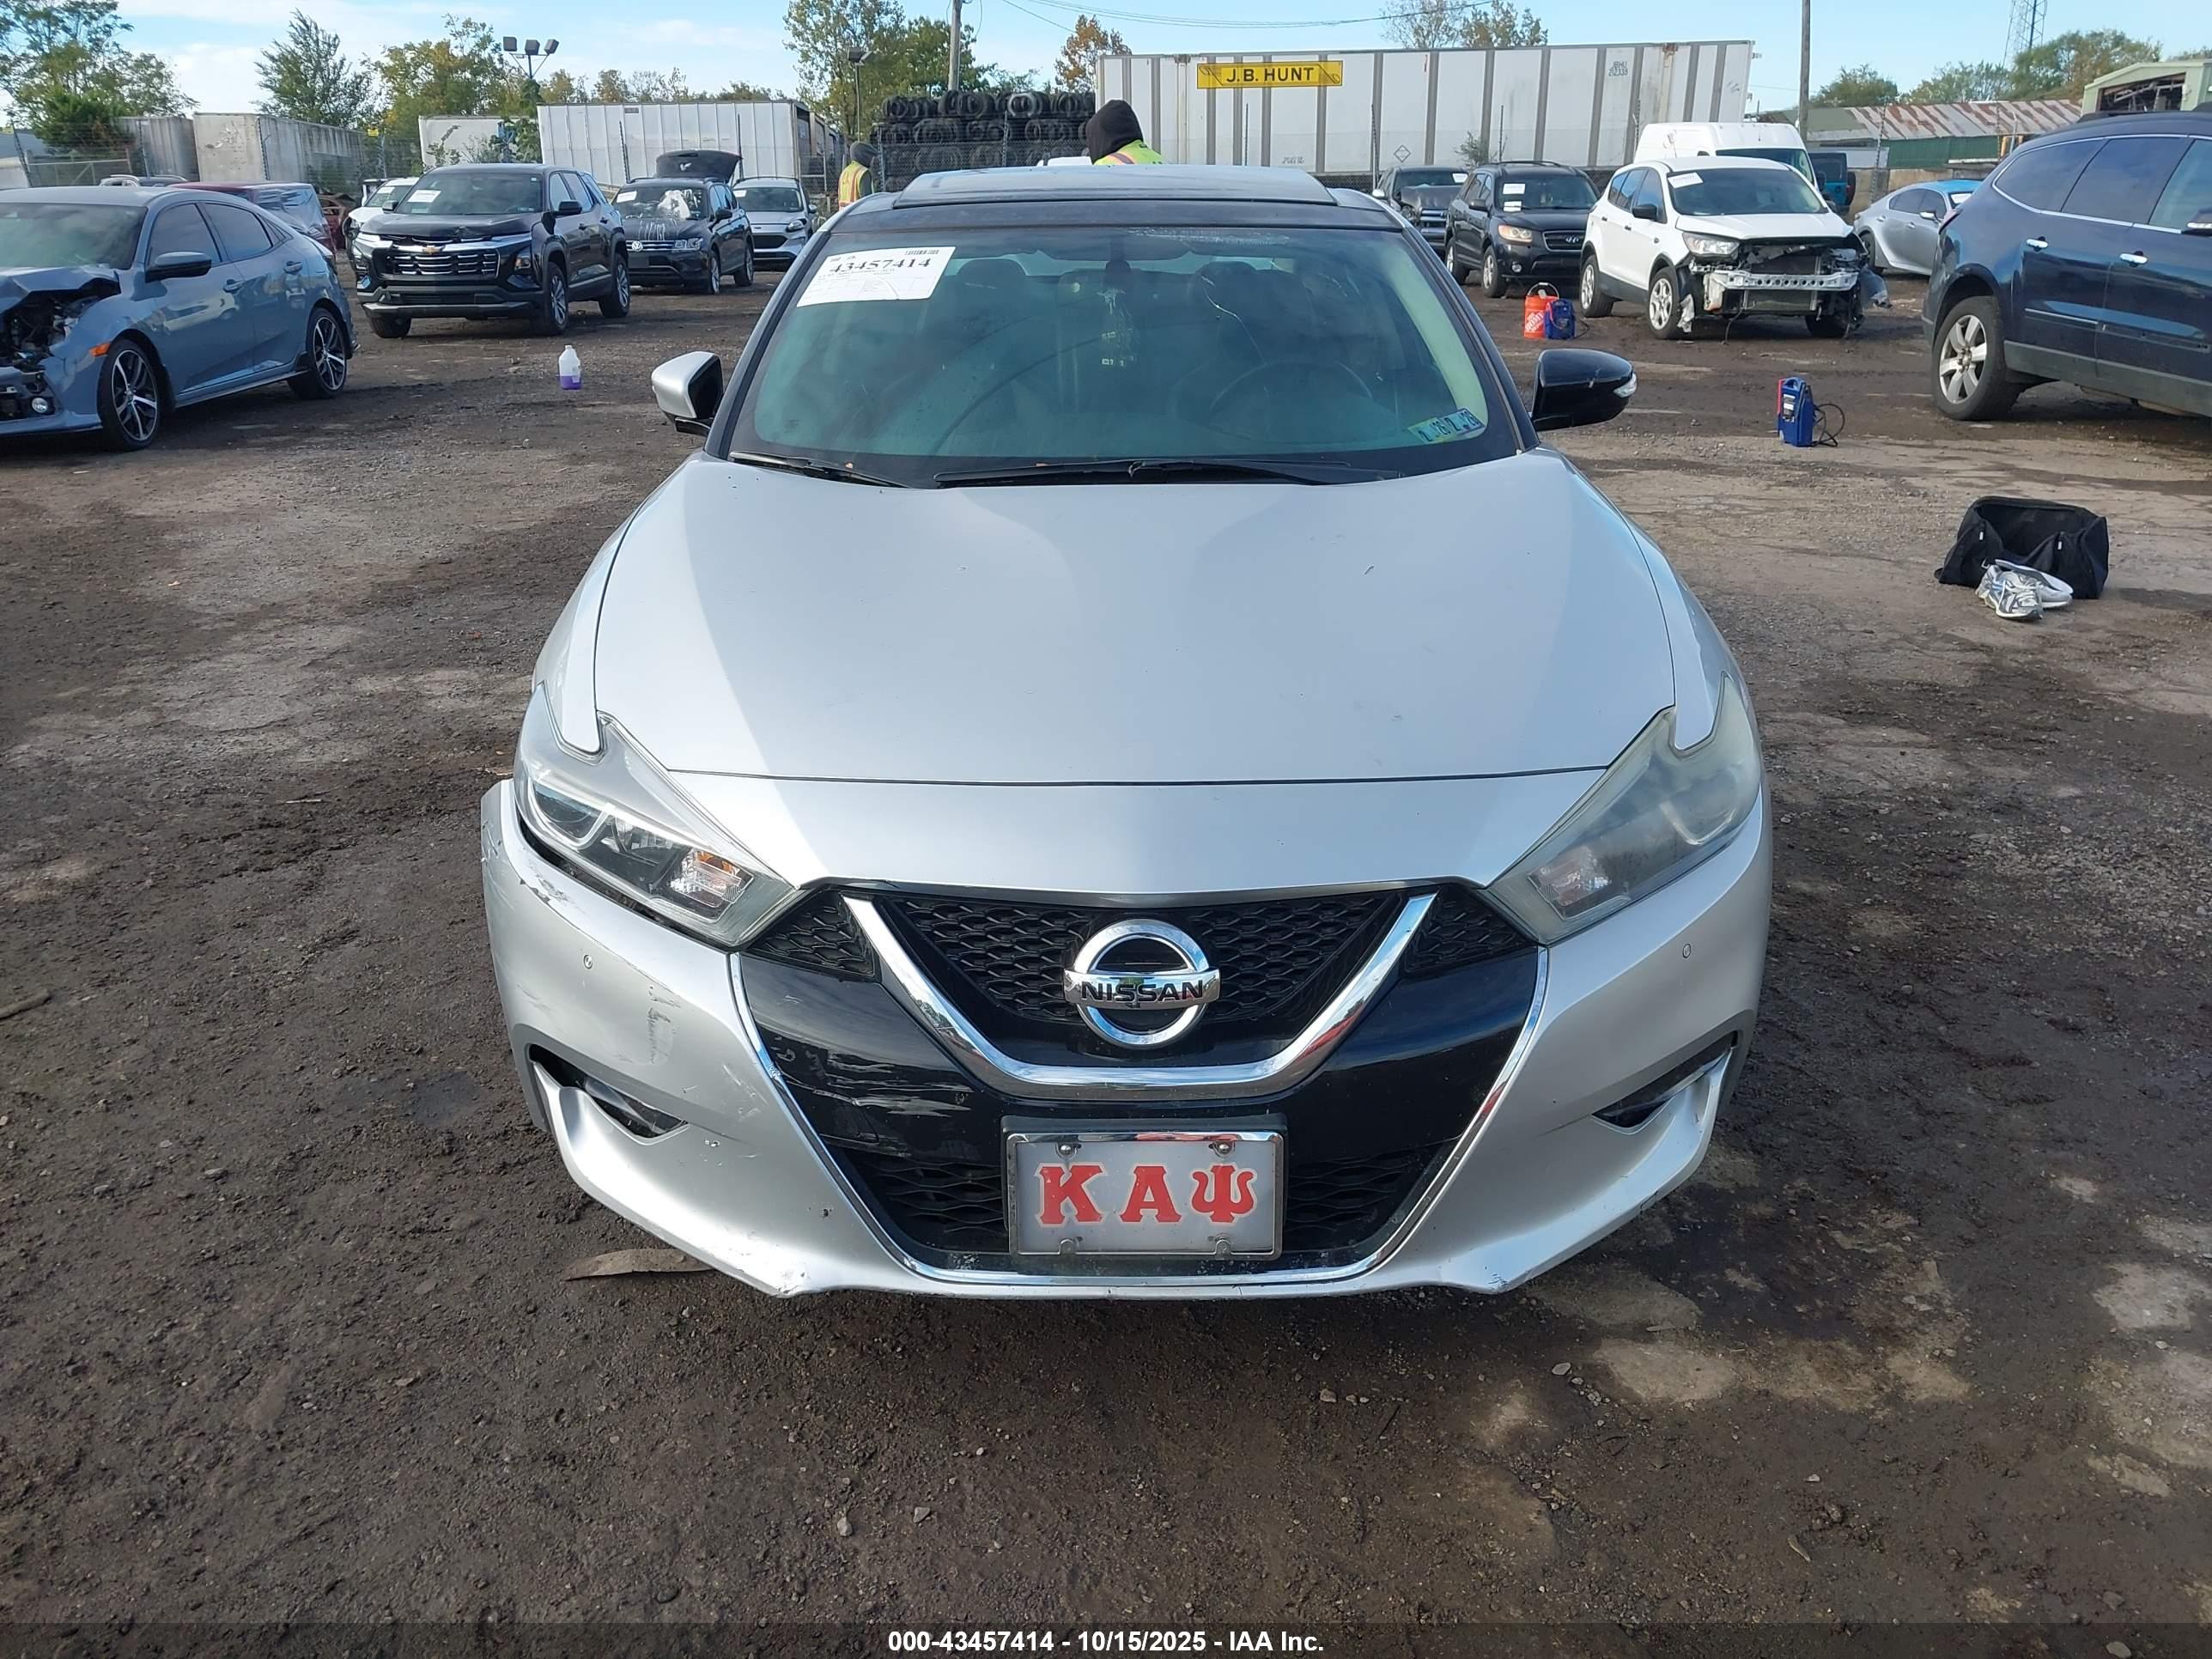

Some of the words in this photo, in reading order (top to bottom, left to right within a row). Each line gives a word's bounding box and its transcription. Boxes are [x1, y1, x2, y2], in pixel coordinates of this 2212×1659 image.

[1226, 69, 1259, 82] J.B.
[1264, 67, 1314, 82] HUNT
[830, 258, 932, 273] 43457414
[1081, 979, 1204, 1003] NISSAN
